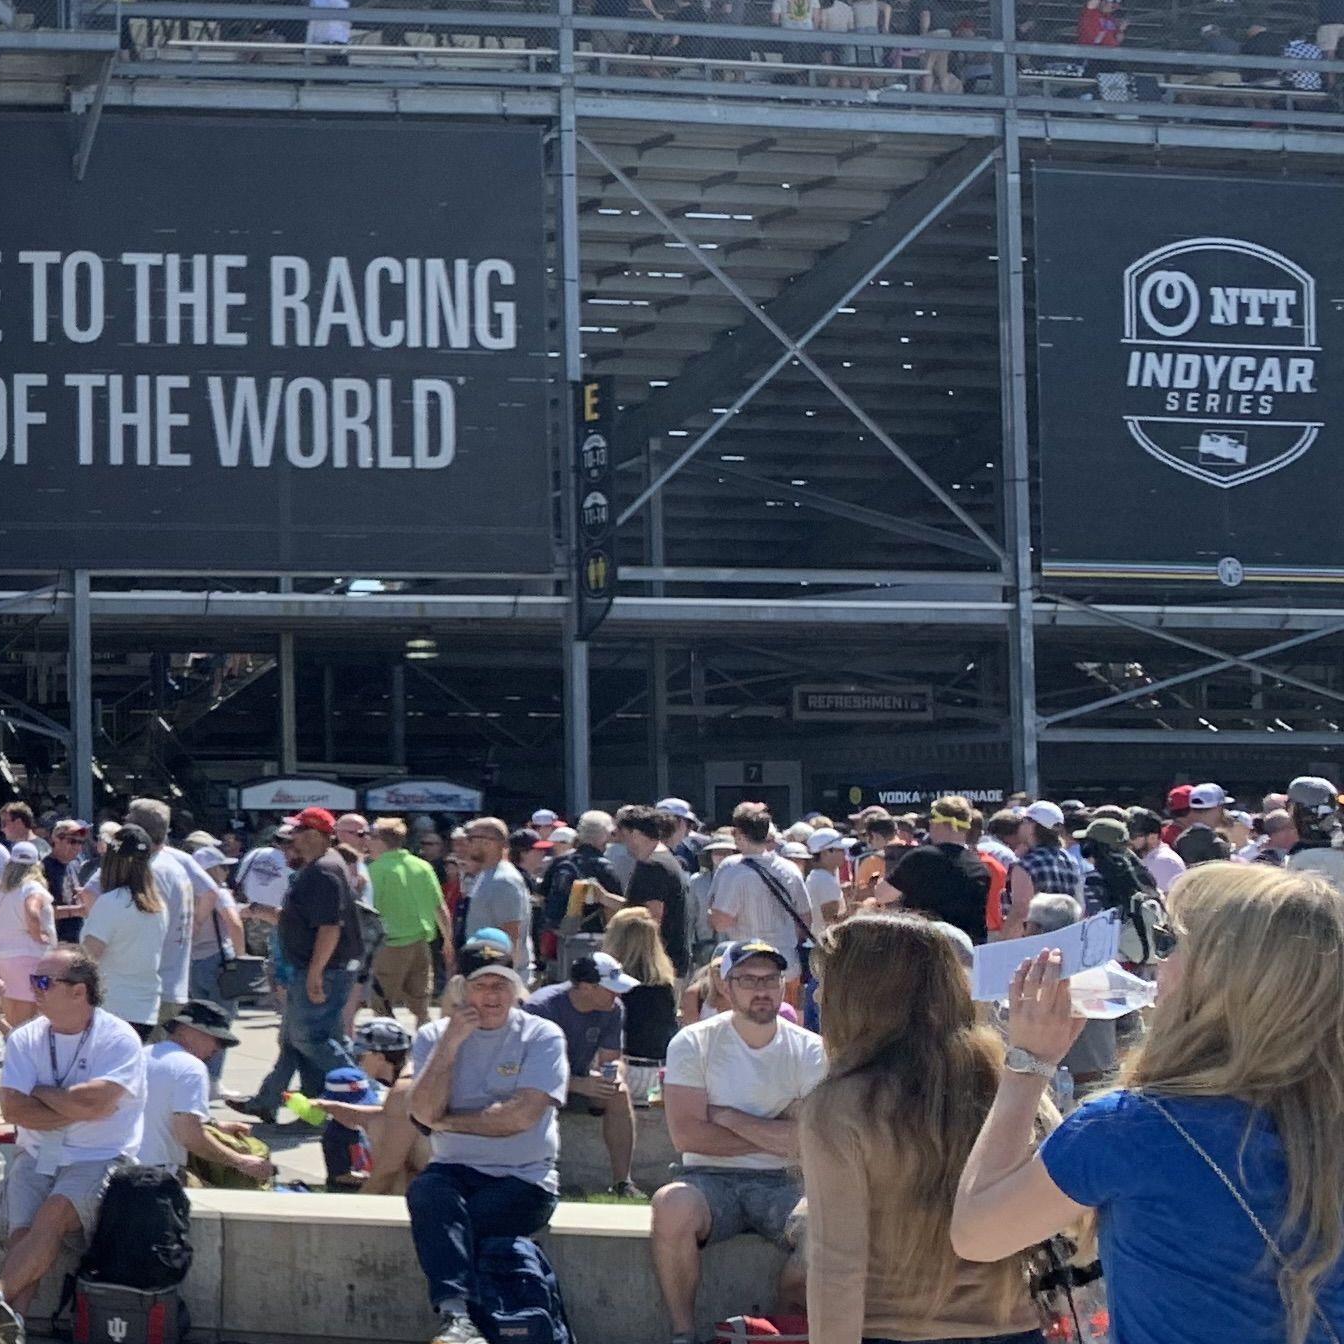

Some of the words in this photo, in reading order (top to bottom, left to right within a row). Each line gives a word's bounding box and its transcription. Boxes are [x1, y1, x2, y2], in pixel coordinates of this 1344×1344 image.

[18, 250, 105, 344] TO
[120, 252, 248, 346] THE
[270, 255, 517, 350] RACING
[1209, 286, 1297, 327] NTT
[1126, 350, 1316, 393] INDYCAR
[64, 373, 191, 466] THE
[207, 376, 456, 469] WORLD
[584, 383, 600, 422] E
[1165, 391, 1274, 415] SERIES
[878, 791, 921, 804] VODKA
